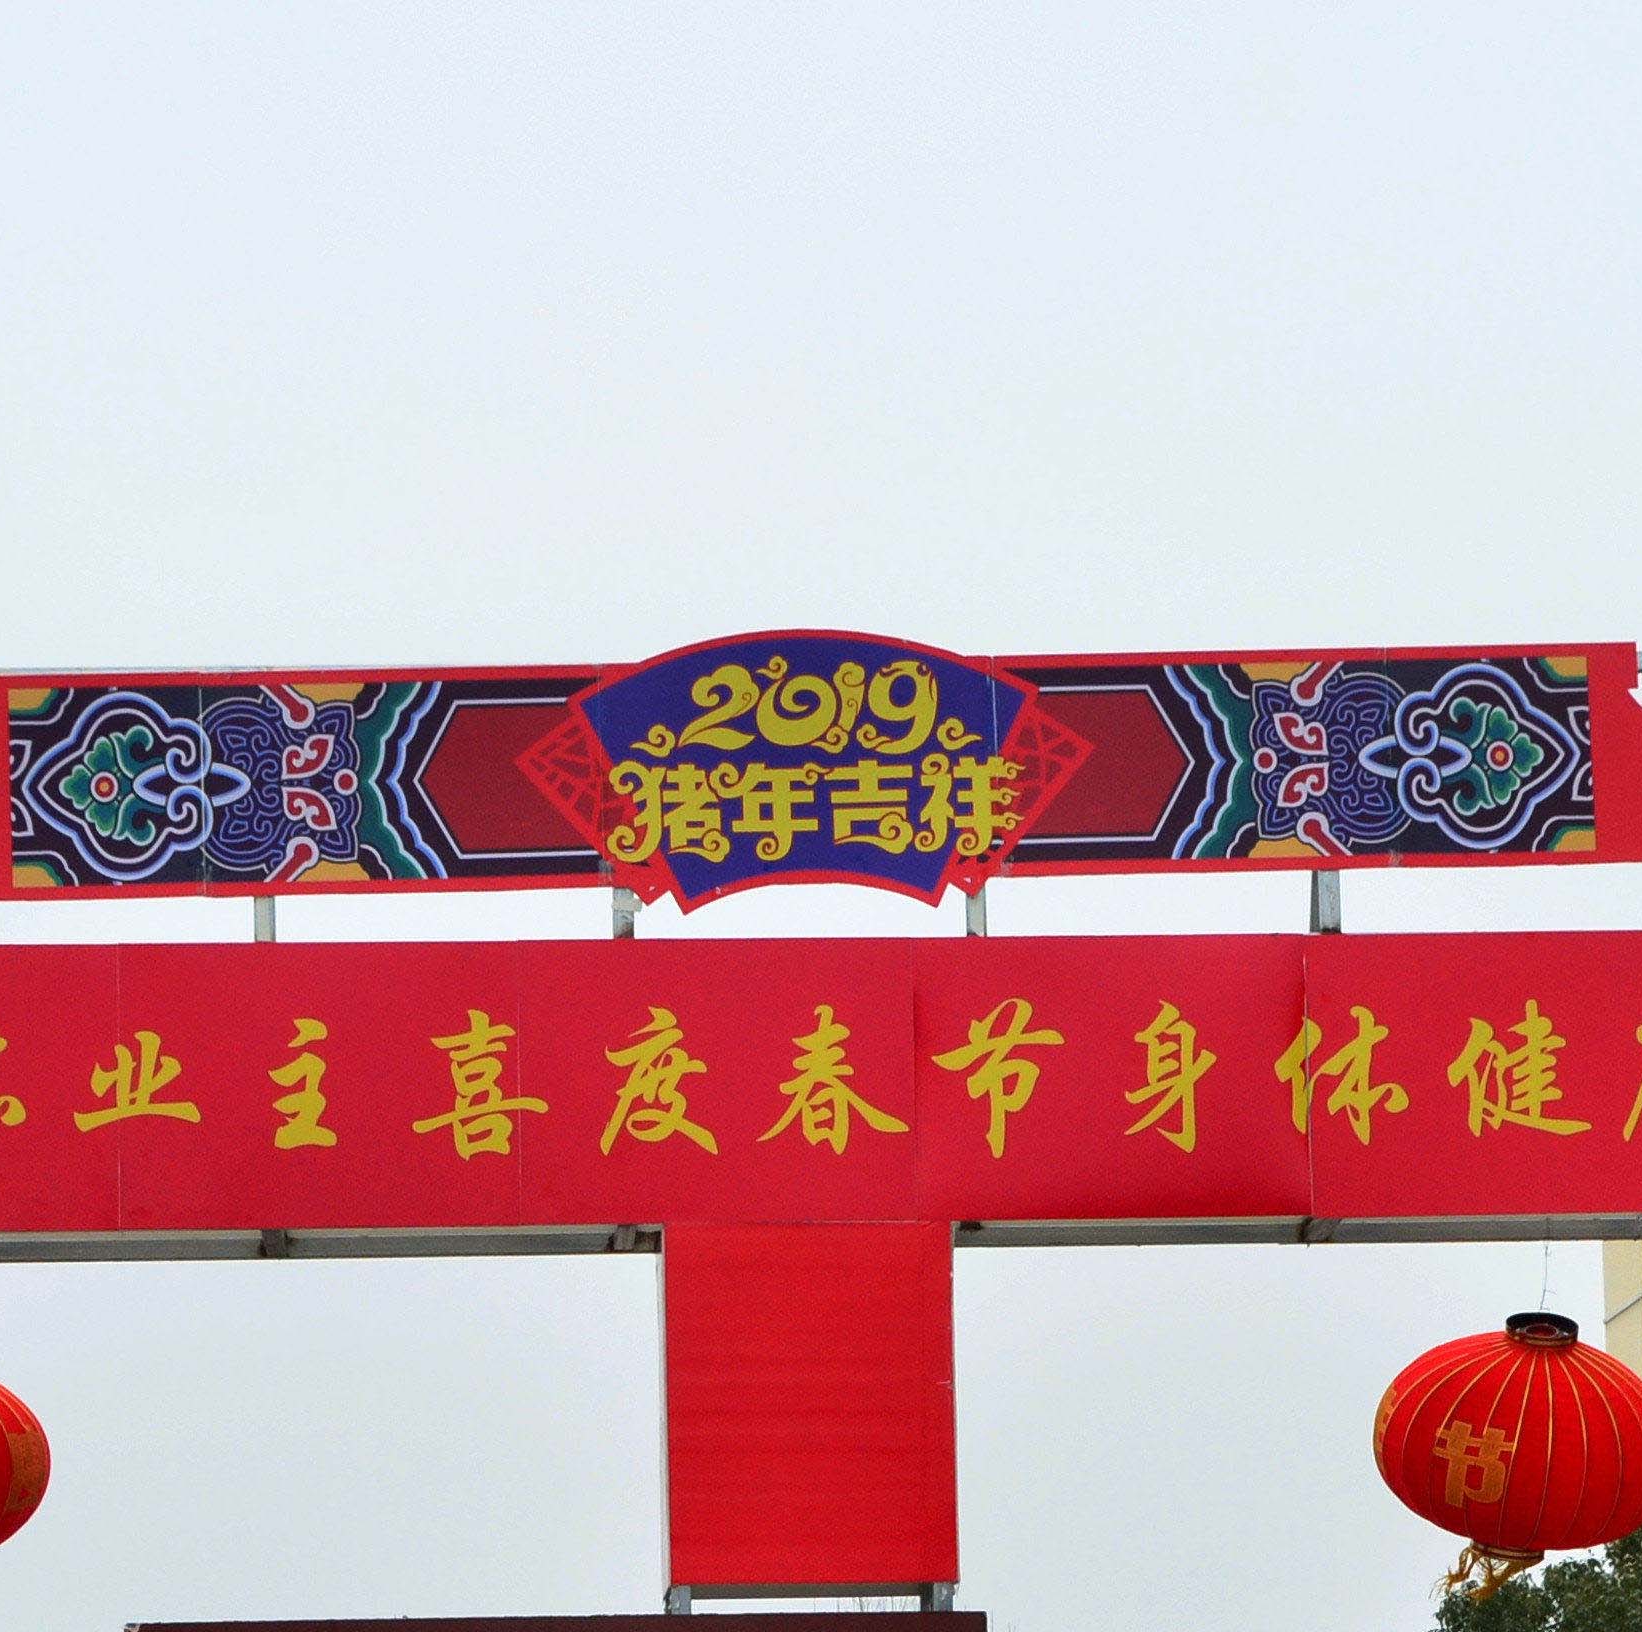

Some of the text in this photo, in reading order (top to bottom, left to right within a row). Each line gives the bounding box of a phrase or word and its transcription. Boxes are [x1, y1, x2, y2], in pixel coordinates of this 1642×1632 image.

[678, 655, 938, 755] 2019
[606, 753, 1026, 863] 猪年吉祥
